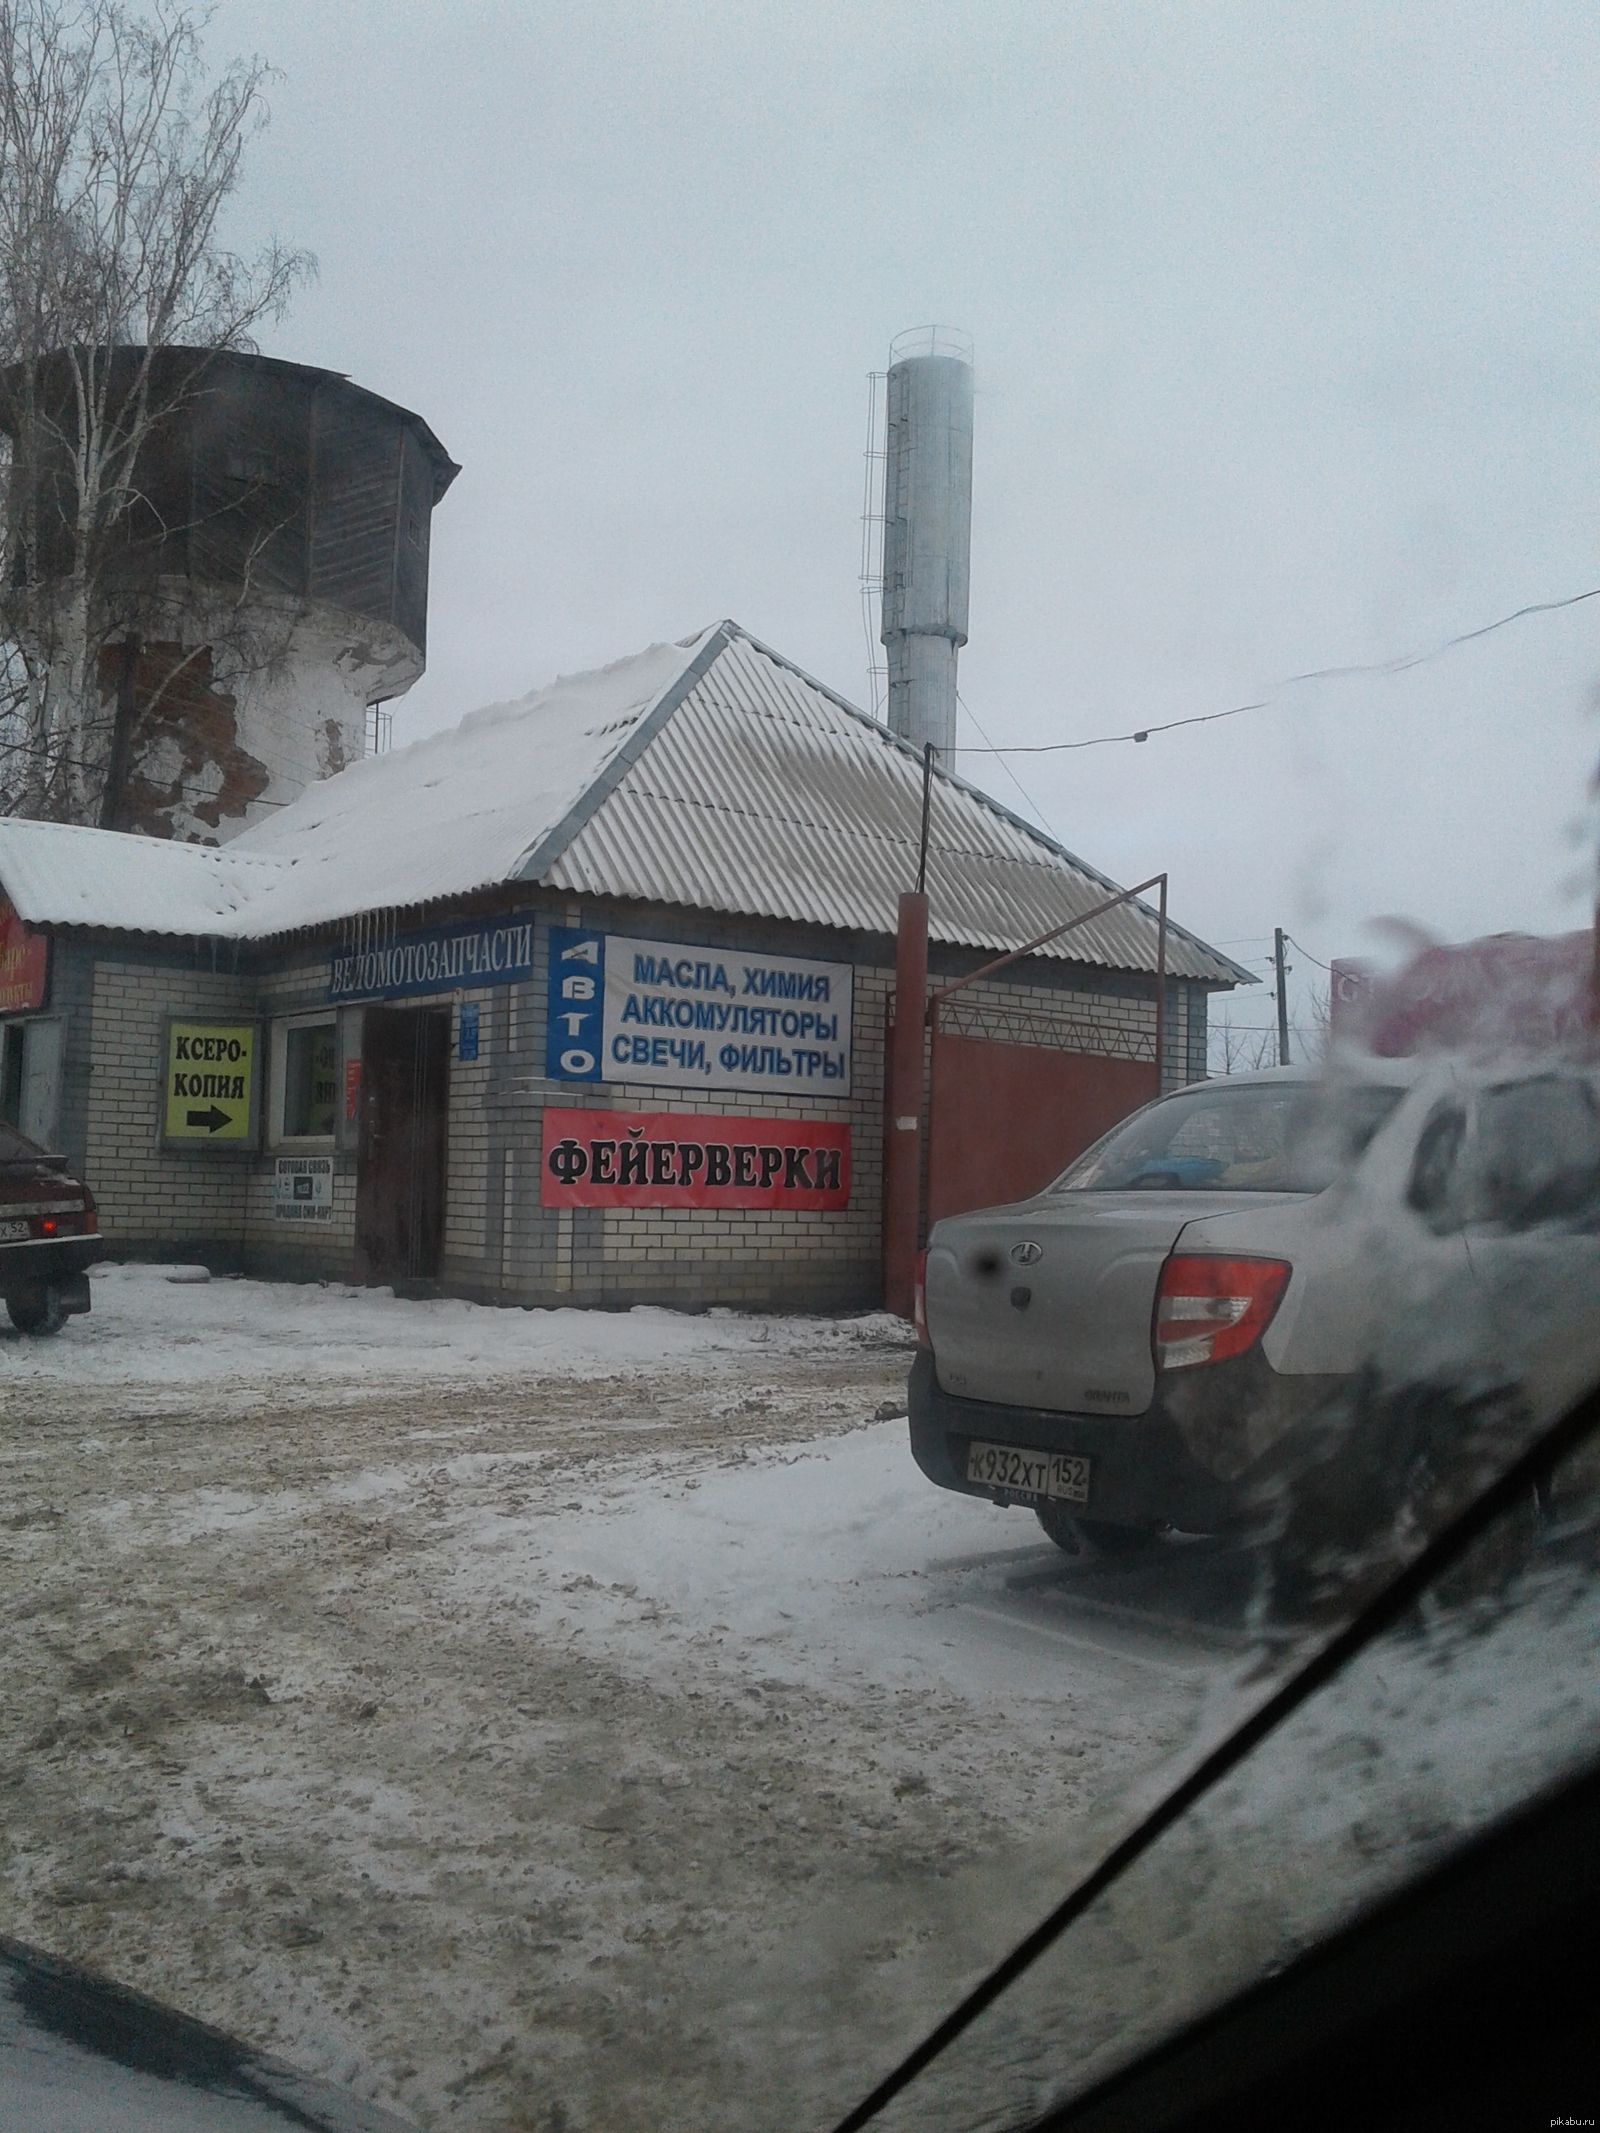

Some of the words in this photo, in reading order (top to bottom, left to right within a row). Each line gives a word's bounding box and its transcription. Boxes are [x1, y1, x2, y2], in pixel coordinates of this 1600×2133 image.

[331, 924, 532, 993] ВЕЛОМОТОЗАПЧАСТИ
[634, 954, 736, 998] МАСЛА,
[742, 967, 830, 1003] ХИМИЯ
[557, 941, 599, 1073] АВТО
[621, 994, 839, 1041] АККОМУЛЯТОРЫ
[175, 1036, 247, 1062] КСЕРО-
[611, 1034, 712, 1075] СВЕЧИ,
[718, 1043, 845, 1079] ФИЛЬТРЫ
[173, 1073, 245, 1099] КОПИЯ
[548, 1126, 842, 1191] ФЕЙЕРВЕРКИ
[1052, 1457, 1085, 1486] 152
[1056, 1485, 1073, 1496] RUS
